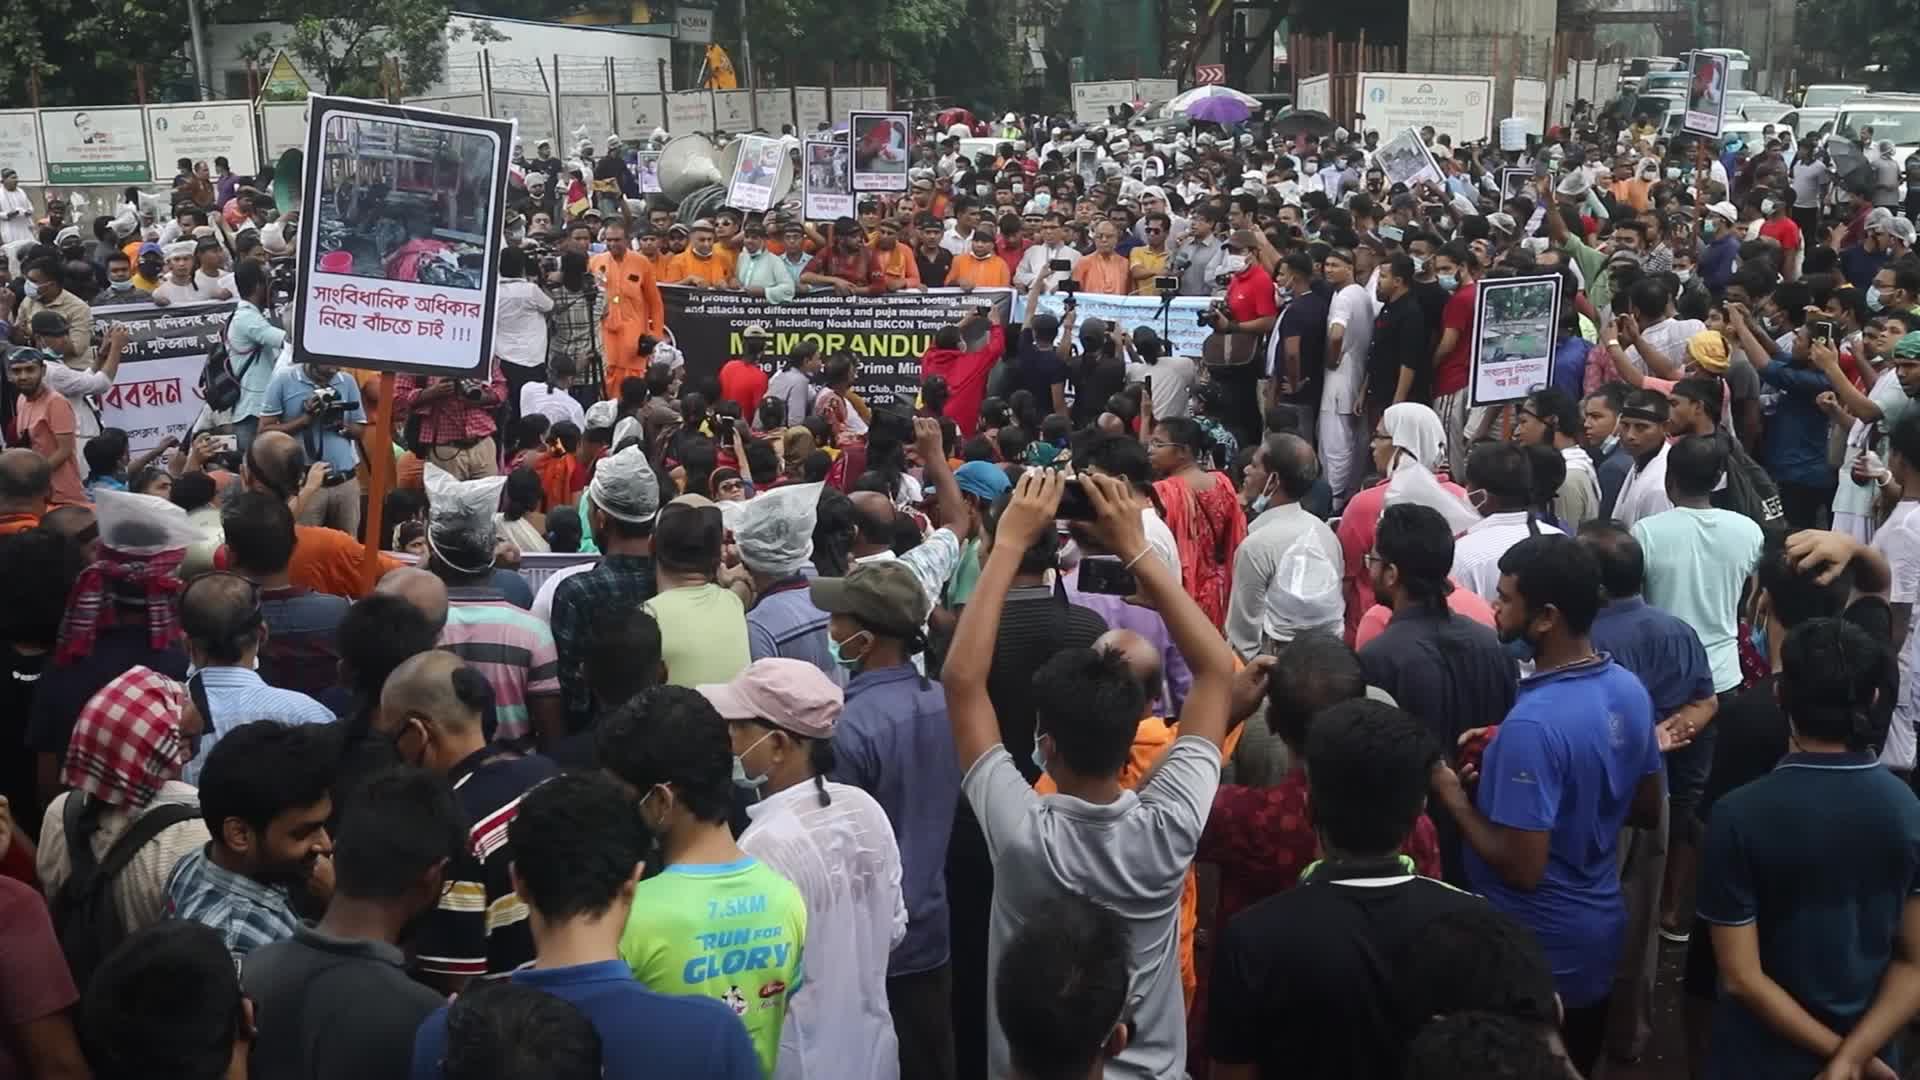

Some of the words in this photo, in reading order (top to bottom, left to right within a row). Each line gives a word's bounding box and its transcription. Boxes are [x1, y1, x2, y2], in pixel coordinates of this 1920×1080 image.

[313, 283, 410, 310] সাংবিধানিক
[414, 294, 481, 318] অধিকার
[702, 295, 739, 304] protest
[846, 295, 857, 303] of
[922, 296, 959, 306] looting,
[707, 306, 744, 314] attacks
[764, 305, 808, 315] different
[810, 306, 851, 316] temples
[854, 307, 872, 316] and
[875, 307, 896, 318] puja
[899, 308, 944, 318] mandaps
[319, 305, 357, 330] নিয়ে
[362, 312, 413, 335] বাঁচতে
[417, 318, 446, 340] চাই
[452, 327, 471, 342] !!!
[730, 319, 773, 329] country,
[775, 318, 824, 329] including
[827, 319, 871, 328] Noakhali
[873, 320, 914, 329] ISKCON
[730, 332, 931, 357] MEMORANDU
[898, 363, 922, 374] Min
[96, 378, 181, 411] ববন্ধন
[868, 385, 893, 394] Club,
[707, 896, 766, 918] 7.5KM
[697, 928, 751, 950] RUN
[753, 926, 782, 940] FOR
[683, 943, 792, 984] GLORY
